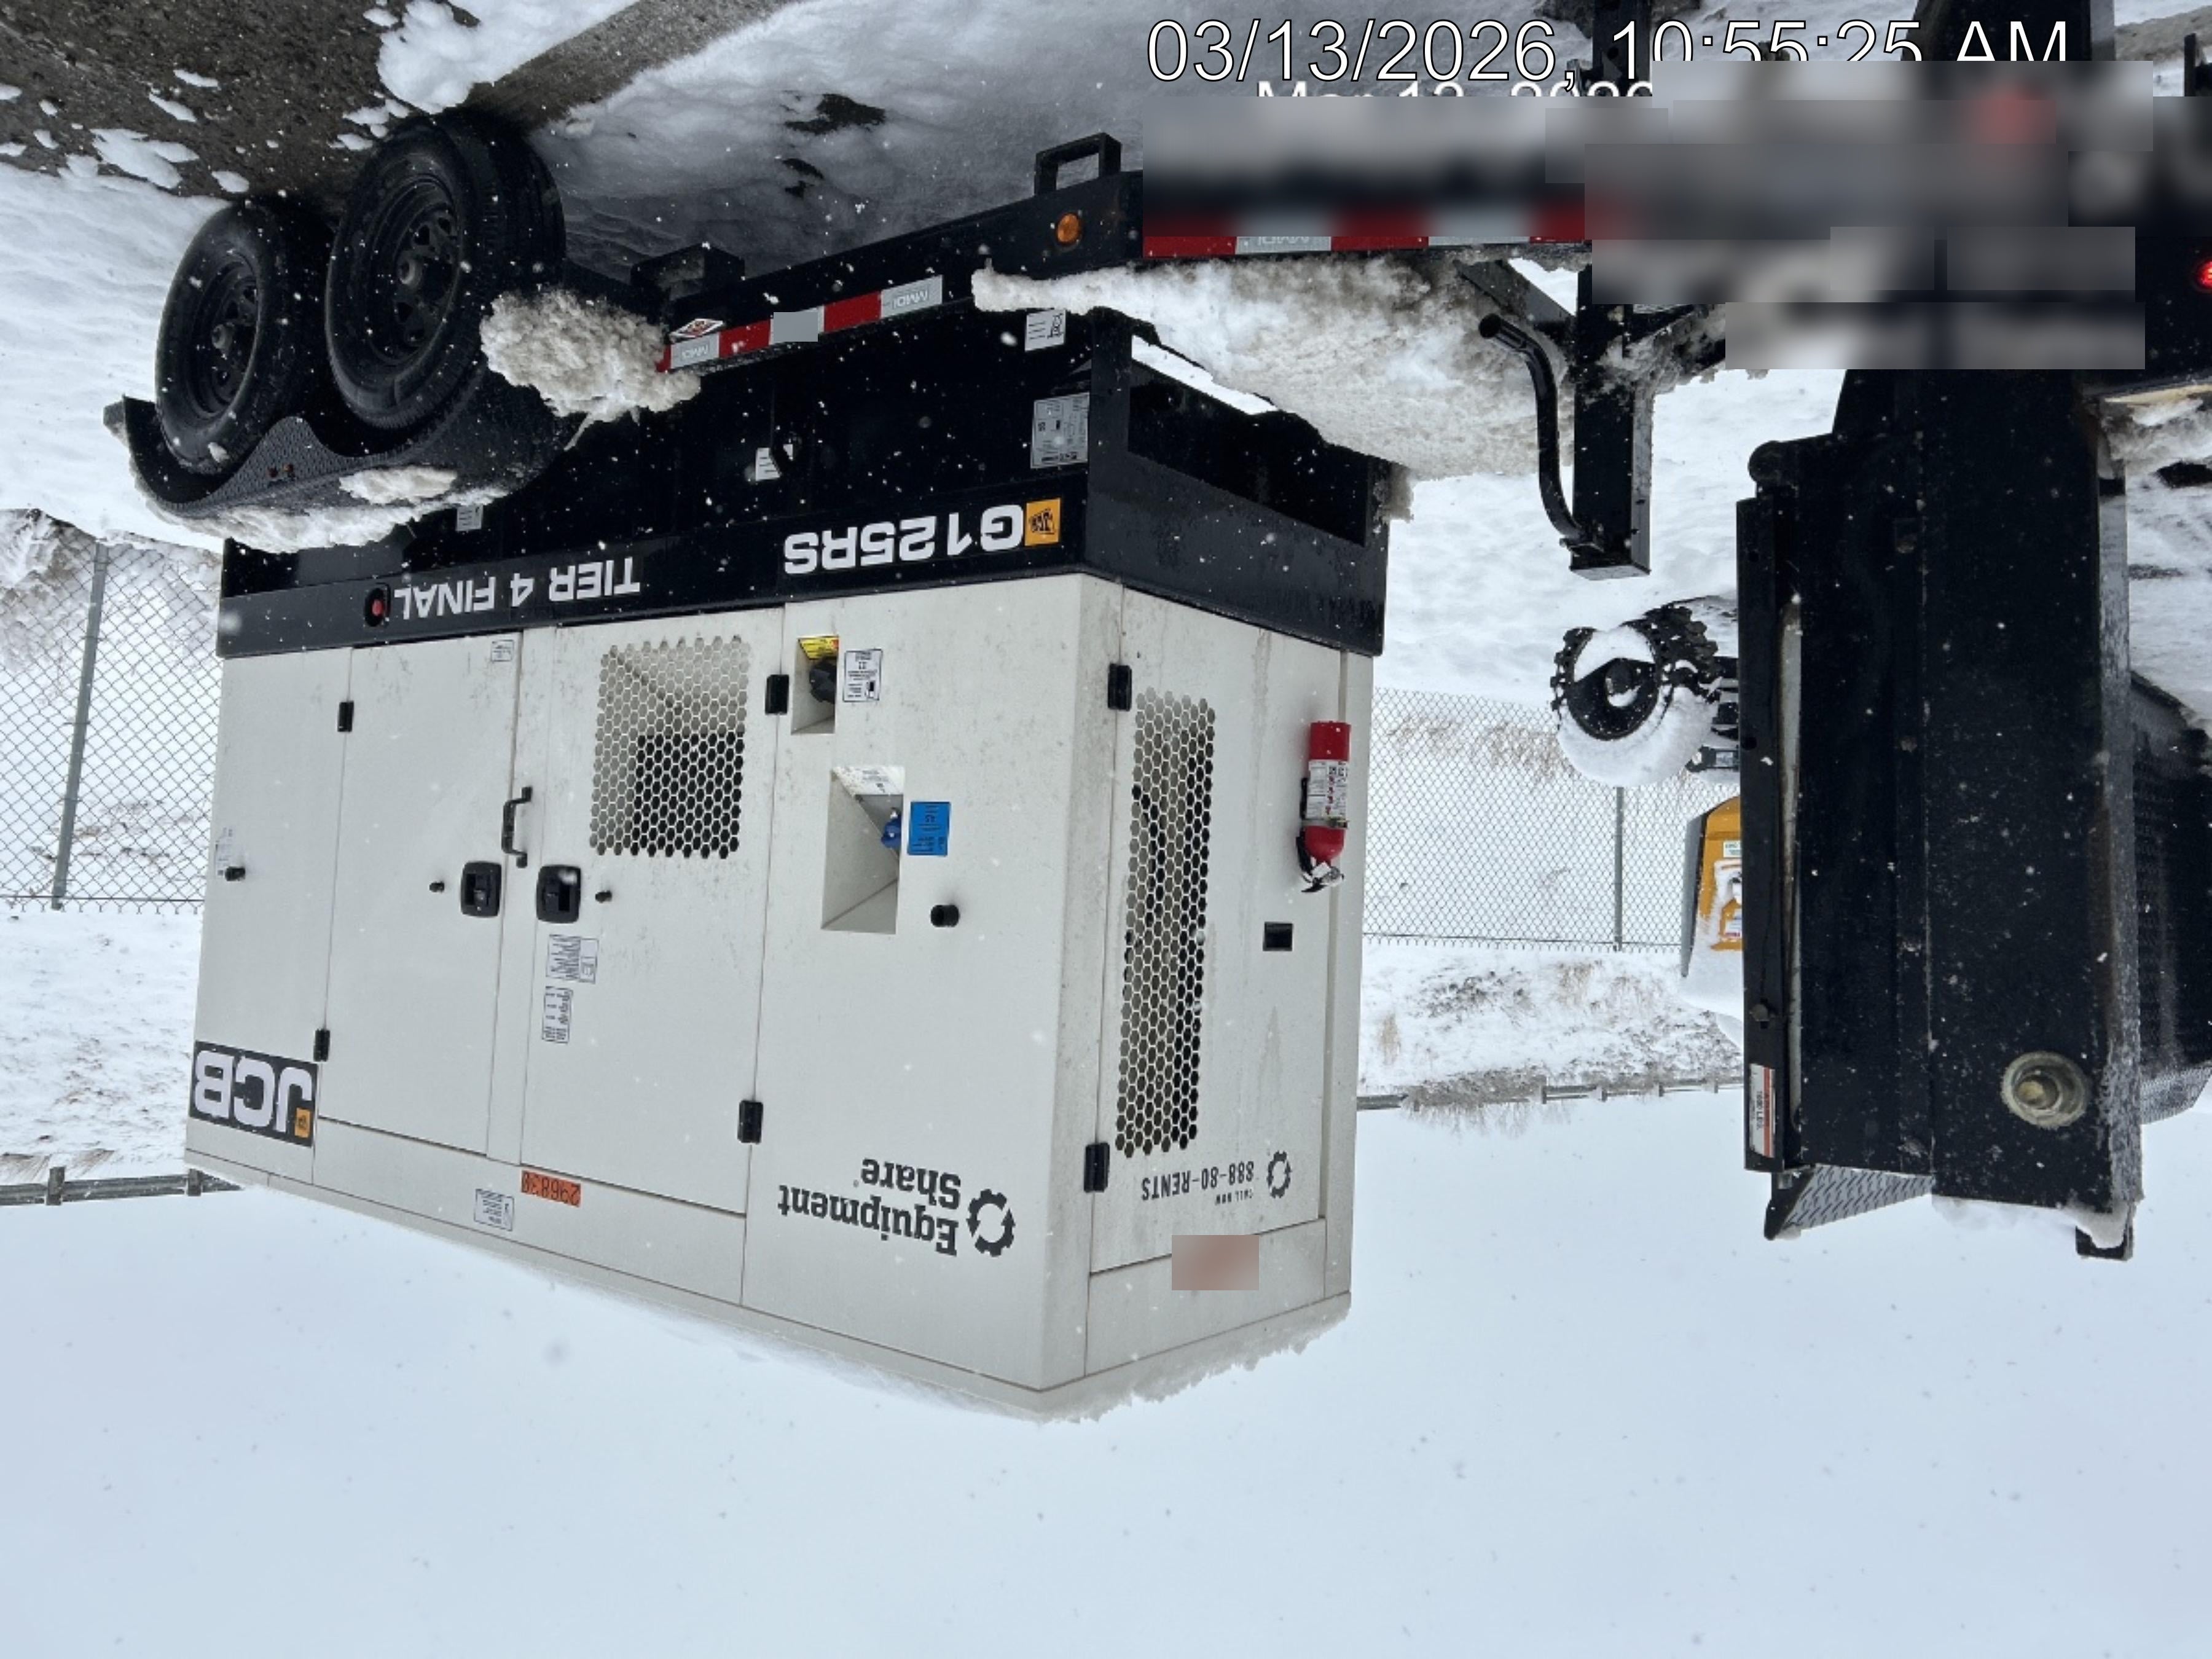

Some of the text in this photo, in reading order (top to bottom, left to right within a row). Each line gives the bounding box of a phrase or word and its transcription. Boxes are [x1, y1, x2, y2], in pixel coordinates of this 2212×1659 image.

[784, 504, 1024, 575] G125RS
[394, 556, 640, 620] TIER 4 FINAL
[194, 1050, 313, 1133] JCB
[860, 1158, 961, 1210] Share
[1142, 1161, 1254, 1201] 888-80-RENTS
[777, 1185, 959, 1257] Equipment
